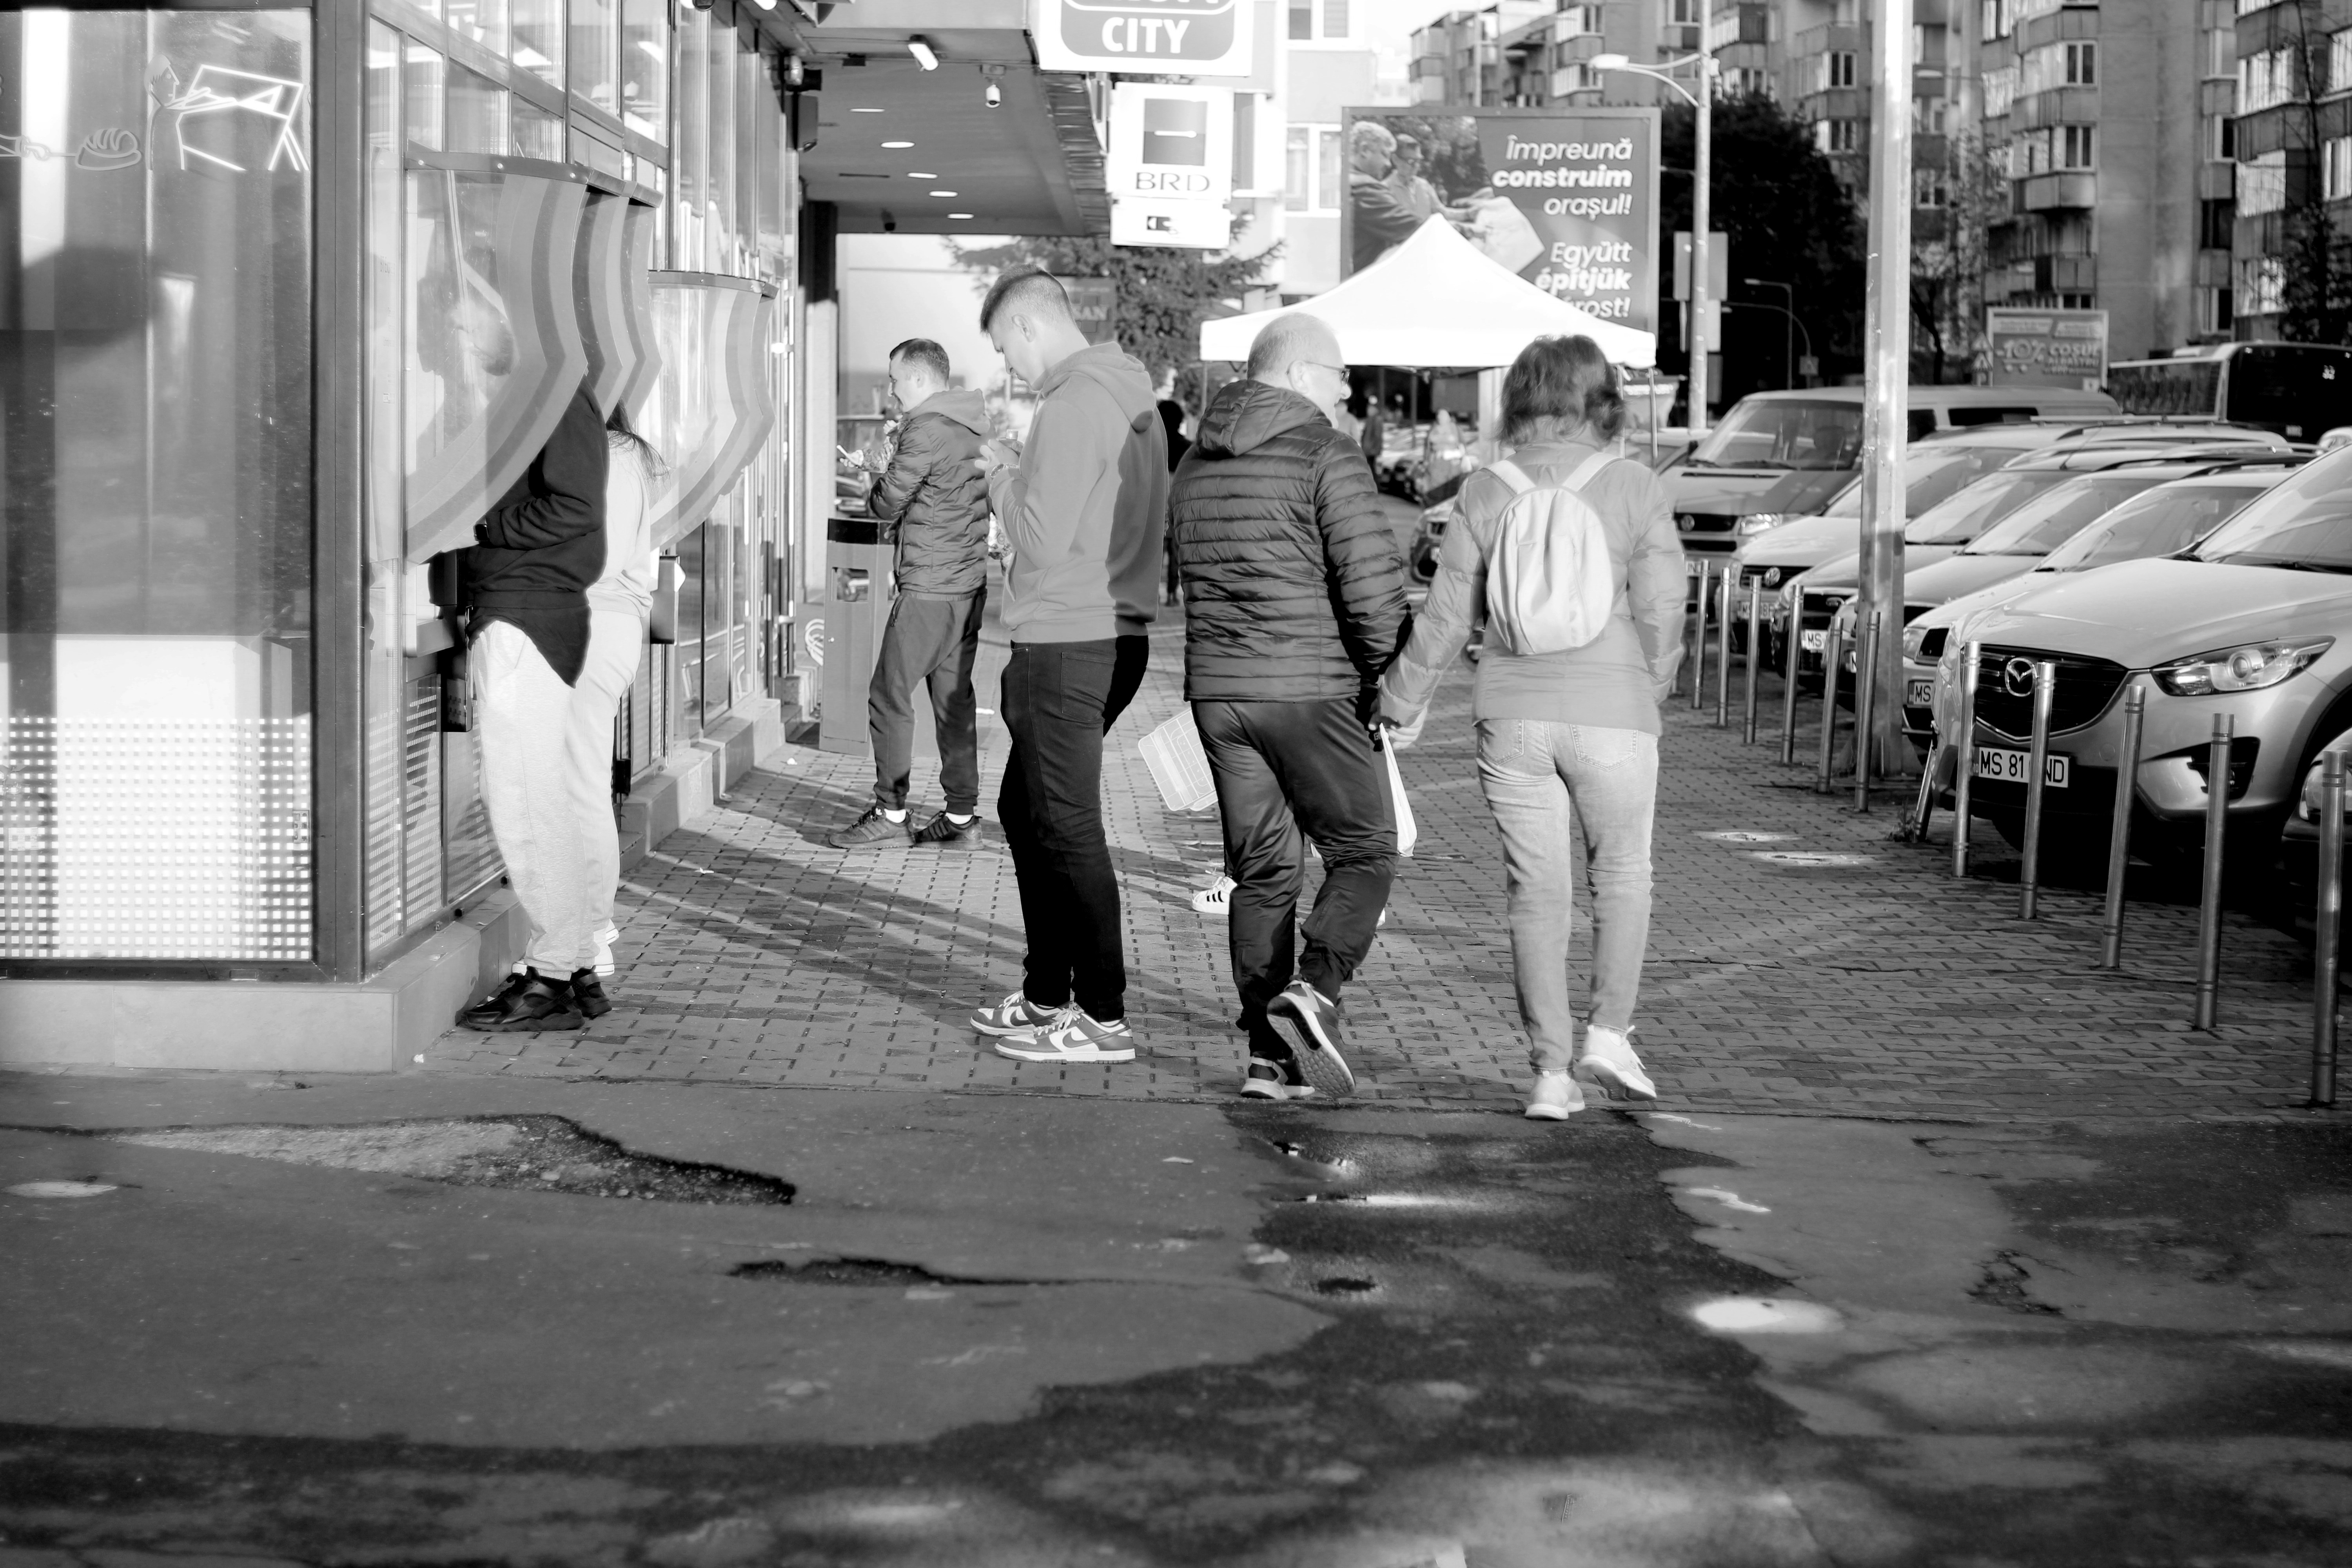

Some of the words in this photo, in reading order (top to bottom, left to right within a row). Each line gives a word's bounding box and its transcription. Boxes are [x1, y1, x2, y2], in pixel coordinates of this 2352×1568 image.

[1102, 16, 1191, 54] CITY
[1506, 134, 1633, 167] Împreună
[1136, 172, 1210, 192] BRD
[1492, 163, 1633, 188] construim
[1550, 240, 1633, 270] Együtt
[1534, 266, 1633, 297] építjük
[1808, 632, 1822, 647] MS
[1915, 685, 1931, 702] MS
[1981, 750, 2002, 775] MS
[2009, 754, 2024, 778] 81
